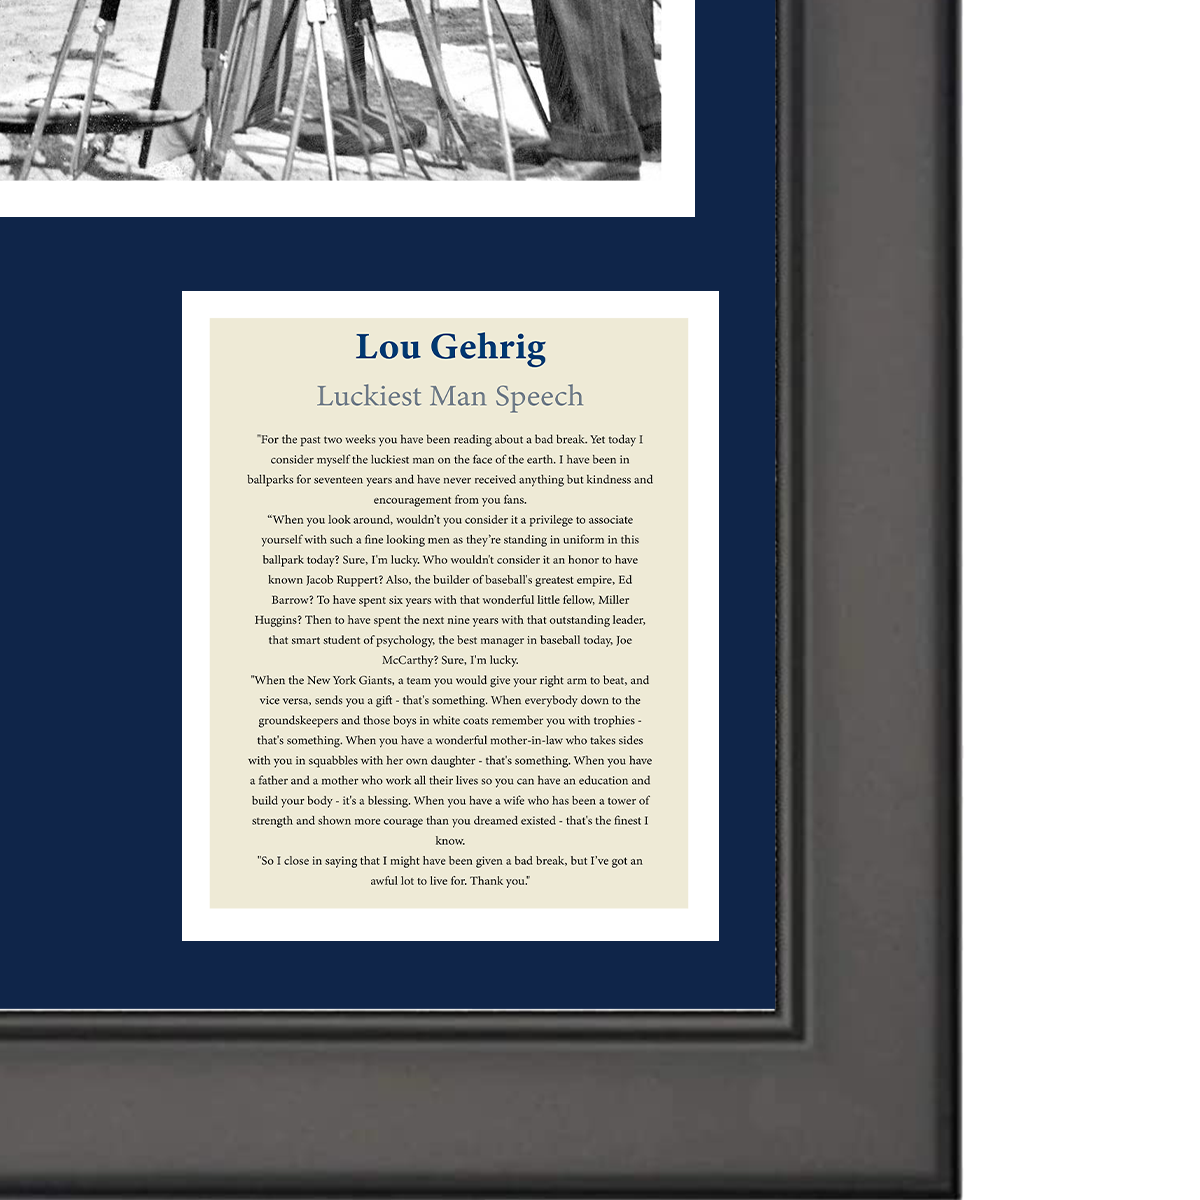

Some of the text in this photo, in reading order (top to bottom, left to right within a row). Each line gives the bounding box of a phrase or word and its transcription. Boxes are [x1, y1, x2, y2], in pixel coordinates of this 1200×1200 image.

[355, 331, 547, 368] Lou Gehrig
[317, 383, 584, 414] Luckiest Man Speech
[282, 434, 298, 444] the
[300, 436, 321, 447] past
[324, 436, 343, 444] two
[345, 434, 376, 444] weeks
[378, 437, 398, 447] you
[400, 434, 424, 444] have
[426, 434, 451, 444] been
[454, 434, 492, 447] reading
[494, 434, 523, 444] about
[535, 434, 553, 444] bad
[556, 434, 588, 444] break.
[590, 435, 605, 444] Yet
[608, 434, 636, 447] today
[639, 435, 643, 444] I
[247, 474, 294, 487] ballparks
[296, 474, 312, 484] for
[313, 476, 363, 484] seventeen
[366, 477, 393, 487] years
[395, 474, 414, 484] and
[417, 474, 441, 484] have
[474, 474, 516, 484] received
[519, 474, 565, 487] anything
[566, 474, 584, 484] but
[586, 474, 632, 484] kindness
[634, 474, 653, 484] and
[374, 494, 527, 507] encouragement from you fans.
[268, 575, 633, 587] known Jacob Ruppert? Also, the builder of baseball's greatest empire, Ed
[255, 615, 646, 627] Huggins? Then to have spent the next nine years with that outstanding leader,
[382, 655, 519, 667] McCarthy? Sure, I'm lucky.
[257, 735, 284, 745] that's
[287, 735, 343, 748] something.
[345, 735, 376, 745] When
[379, 738, 398, 748] you
[401, 735, 424, 745] have
[435, 735, 487, 745] wonderful
[490, 735, 563, 745] mother-in-law
[565, 735, 588, 745] who
[590, 735, 616, 745] takes
[618, 735, 644, 745] sides
[258, 775, 288, 785] father
[290, 775, 310, 785] and
[321, 775, 359, 785] mother
[361, 775, 383, 785] who
[386, 775, 412, 785] work
[414, 775, 426, 785] all
[429, 775, 454, 785] their
[456, 775, 478, 785] lives
[495, 778, 514, 788] you
[537, 775, 561, 785] have
[579, 775, 628, 785] education
[631, 775, 651, 785] and
[435, 836, 465, 845] know.
[370, 876, 398, 886] awful
[401, 876, 414, 885] lot
[417, 877, 427, 885] to
[430, 876, 448, 886] live
[451, 876, 467, 886] for.
[470, 876, 504, 885] Thank
